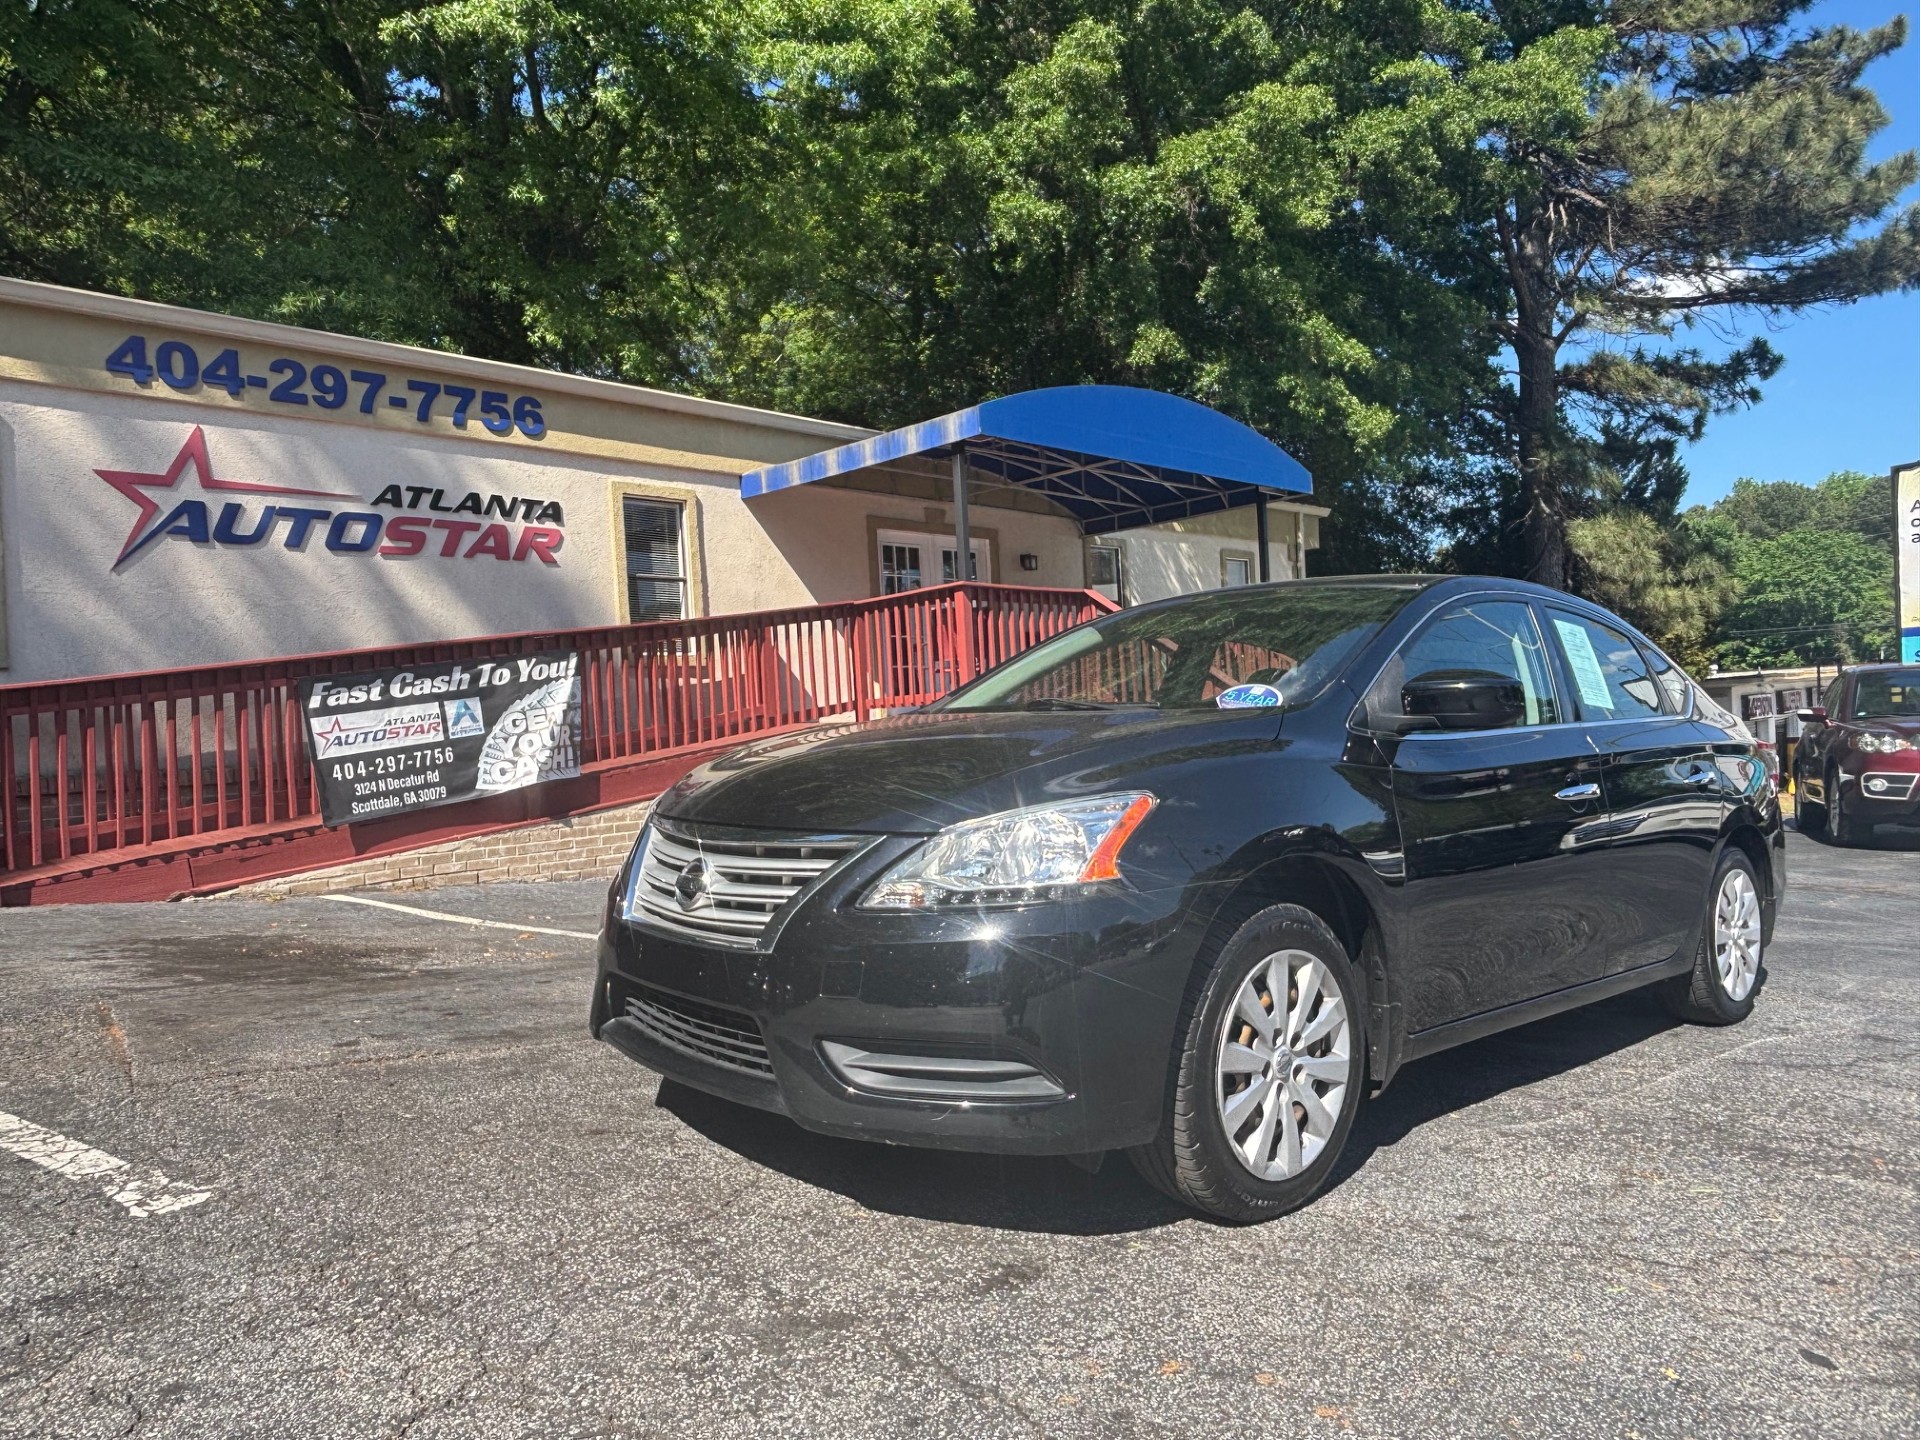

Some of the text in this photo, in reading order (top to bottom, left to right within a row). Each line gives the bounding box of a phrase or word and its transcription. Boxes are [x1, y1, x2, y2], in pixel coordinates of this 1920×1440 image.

[105, 335, 546, 437] 404-297-7756
[370, 484, 563, 523] ATLANTA
[309, 652, 578, 709] Fast Cash To You!
[1225, 691, 1238, 700] 5
[1239, 691, 1277, 706] YEAR
[383, 712, 440, 728] ATLANTA
[503, 703, 567, 734] GET
[498, 724, 570, 759] YOUR
[332, 747, 454, 781] 404-297-7756
[490, 747, 574, 784] CASH!
[351, 786, 447, 814] Scottdale, GA 30079
[354, 770, 439, 796] 3124 N Decatur Rd
